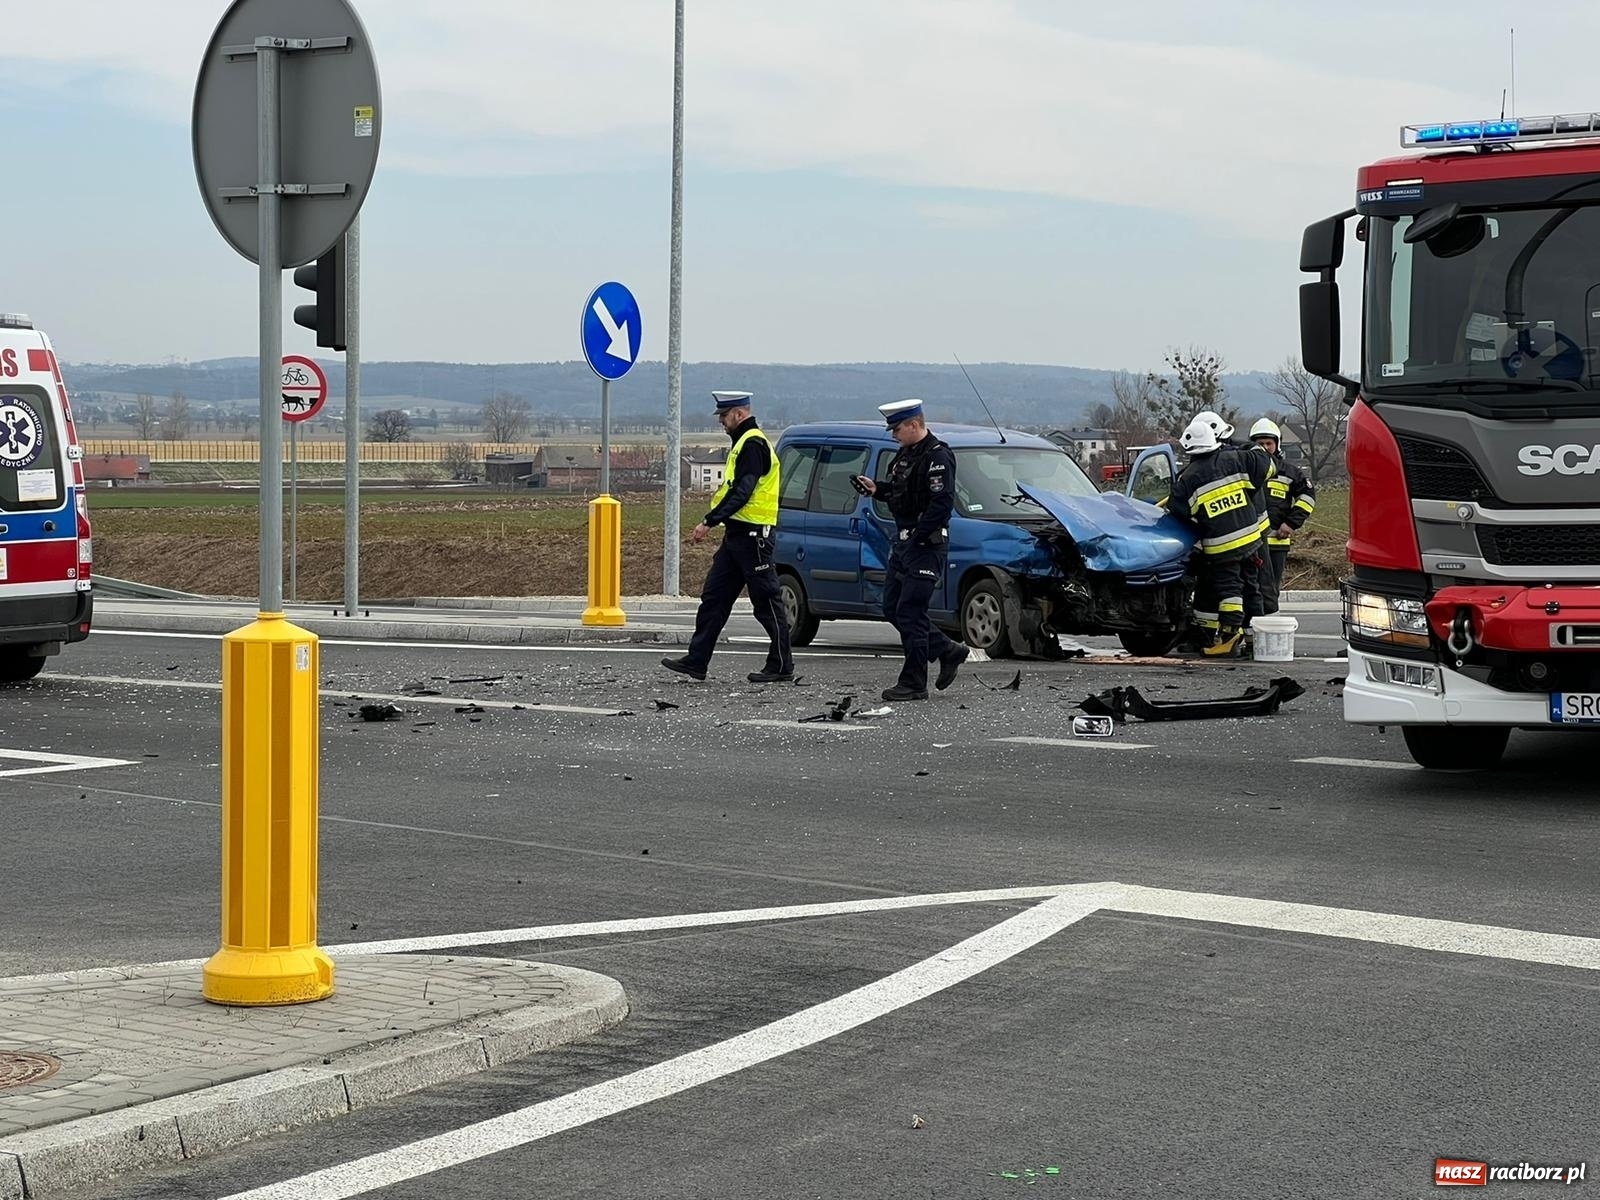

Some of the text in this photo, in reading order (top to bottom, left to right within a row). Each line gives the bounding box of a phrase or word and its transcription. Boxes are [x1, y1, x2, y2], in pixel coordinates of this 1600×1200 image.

[0, 348, 18, 377] S
[13, 398, 43, 446] RATOWNICTWO
[0, 453, 35, 467] EDYCZNE
[1566, 695, 1600, 716] SR
